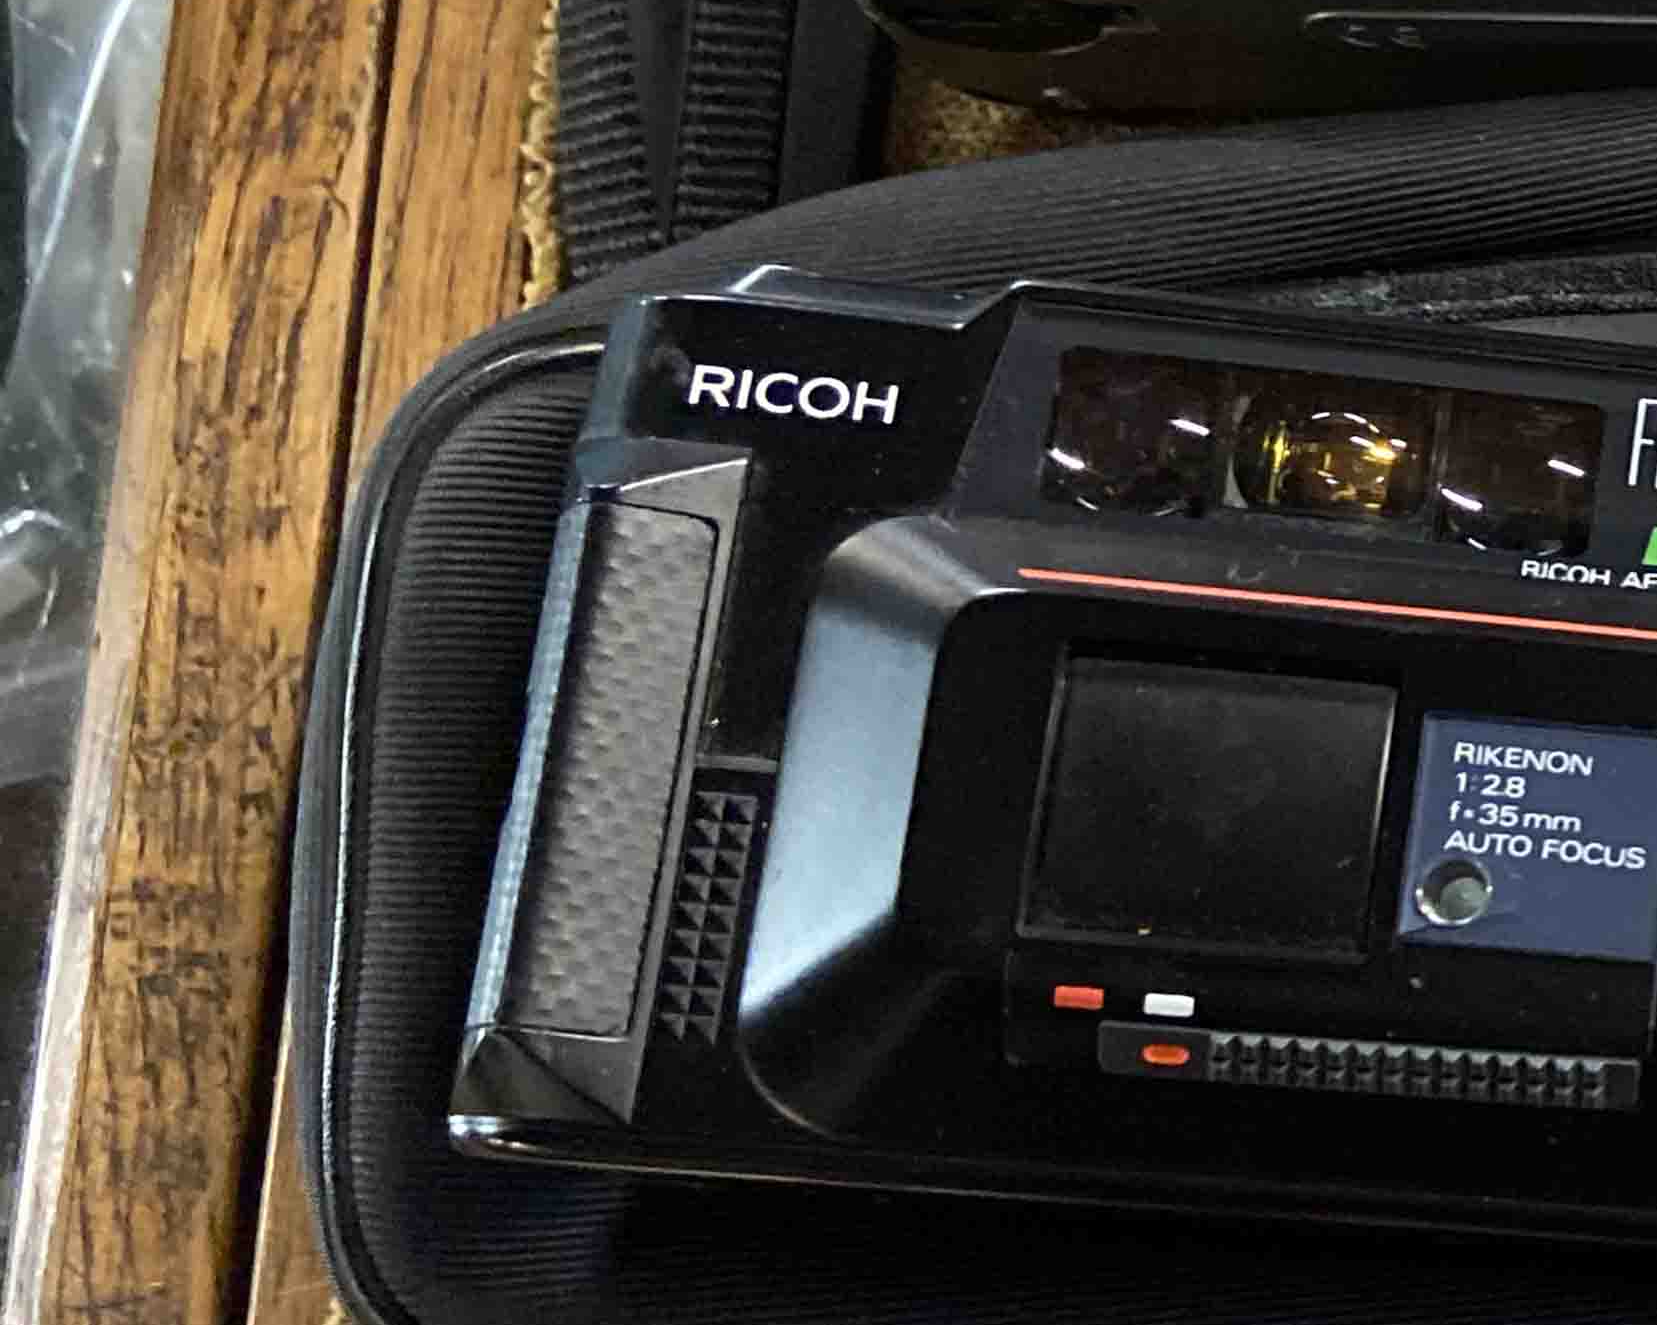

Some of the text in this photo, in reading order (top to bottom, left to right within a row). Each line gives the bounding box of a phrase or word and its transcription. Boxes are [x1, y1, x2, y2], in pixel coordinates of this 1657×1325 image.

[688, 363, 900, 425] RICOH
[1520, 559, 1611, 587] RICOH
[1453, 741, 1594, 777] RIKENON
[1443, 829, 1648, 870] AUTO FOCUS
